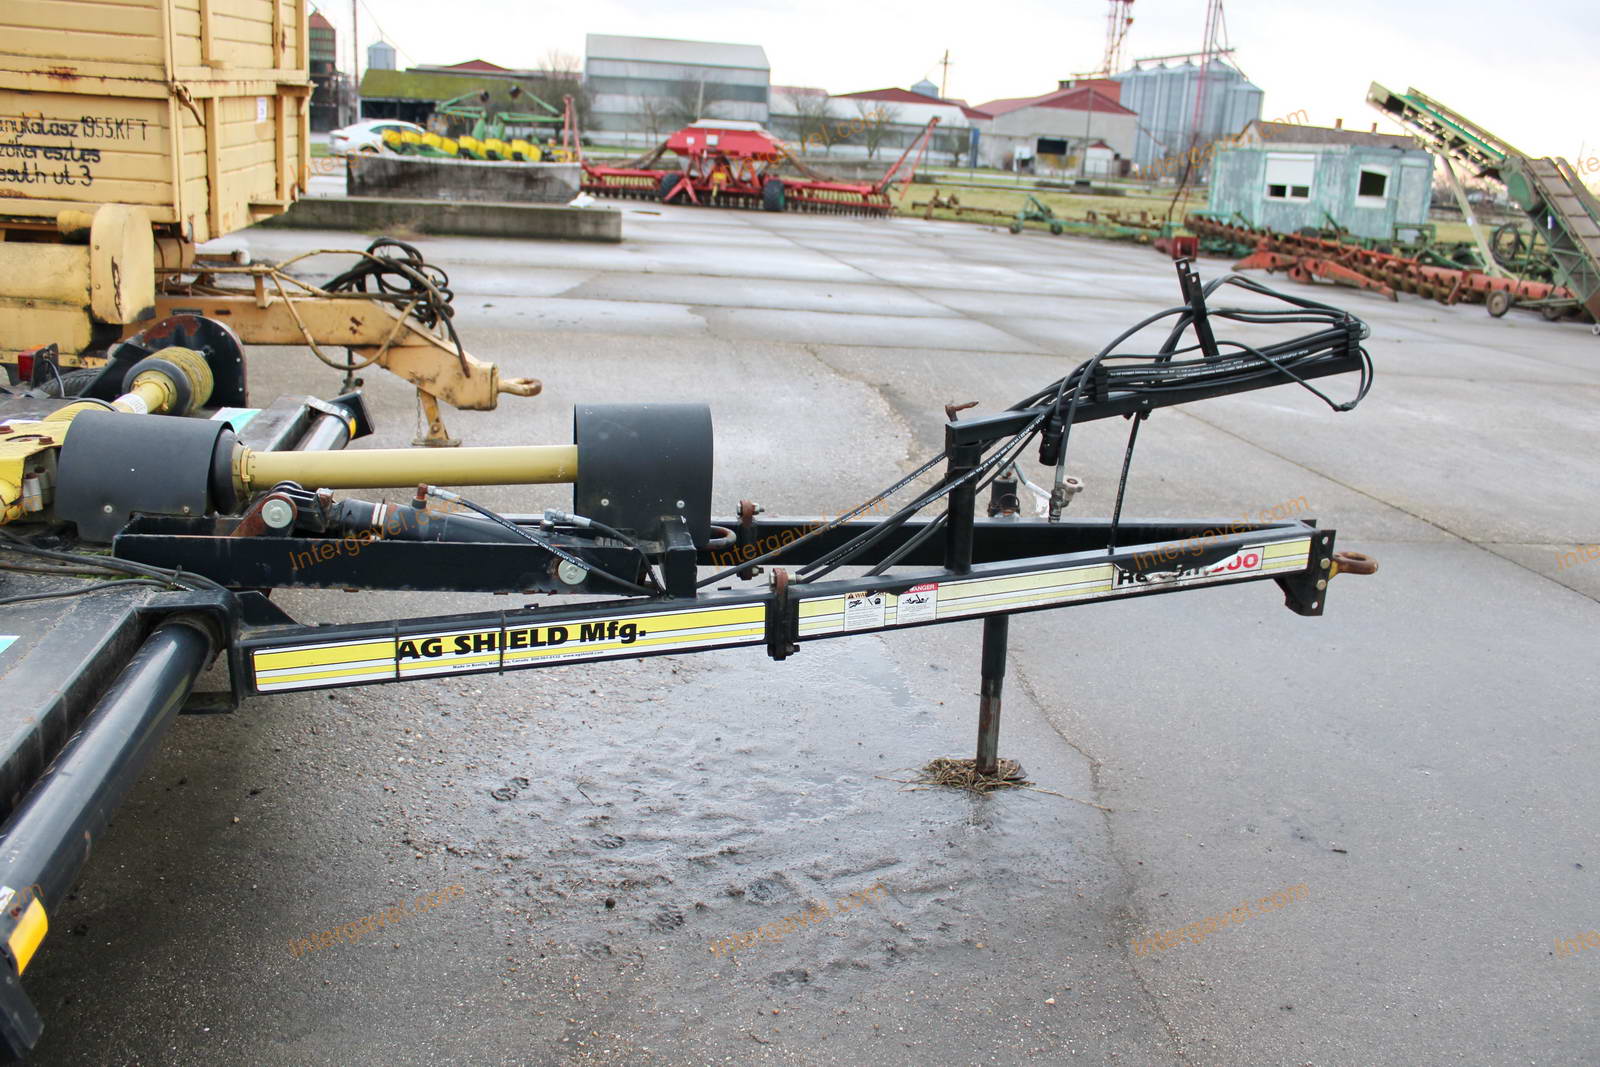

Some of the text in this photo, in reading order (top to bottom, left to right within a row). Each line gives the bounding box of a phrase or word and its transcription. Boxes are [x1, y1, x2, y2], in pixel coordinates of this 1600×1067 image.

[79, 165, 94, 187] 3
[1211, 553, 1259, 573] 00
[908, 583, 936, 593] ANGER
[395, 638, 443, 660] AG
[579, 621, 647, 644] Mfg.
